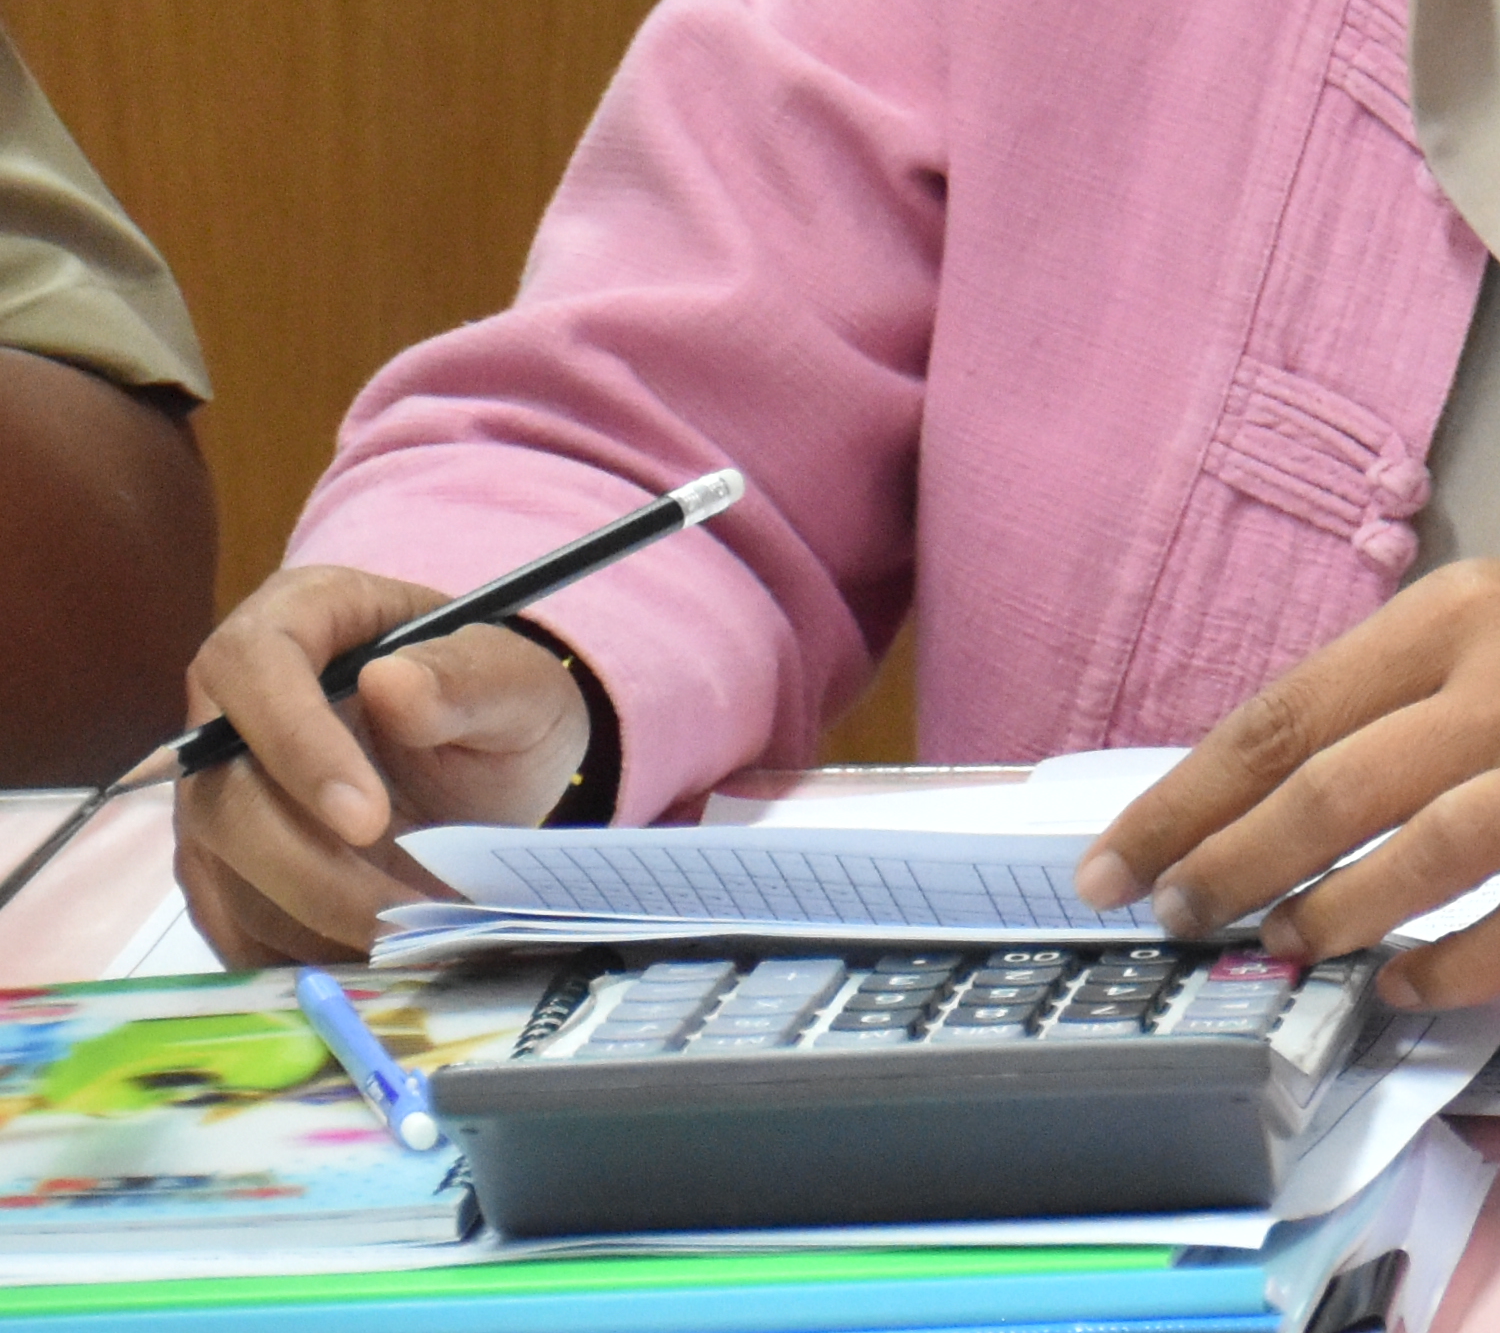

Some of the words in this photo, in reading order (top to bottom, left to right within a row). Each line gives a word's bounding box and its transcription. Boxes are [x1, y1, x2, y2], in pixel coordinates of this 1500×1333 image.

[1003, 950, 1060, 964] 00
[1004, 969, 1034, 981] 2
[1121, 966, 1139, 978] 1
[888, 974, 921, 986] 3
[989, 987, 1021, 999] 5
[1105, 985, 1138, 997] 4
[874, 993, 905, 1005] 6
[1089, 1005, 1121, 1016] 7
